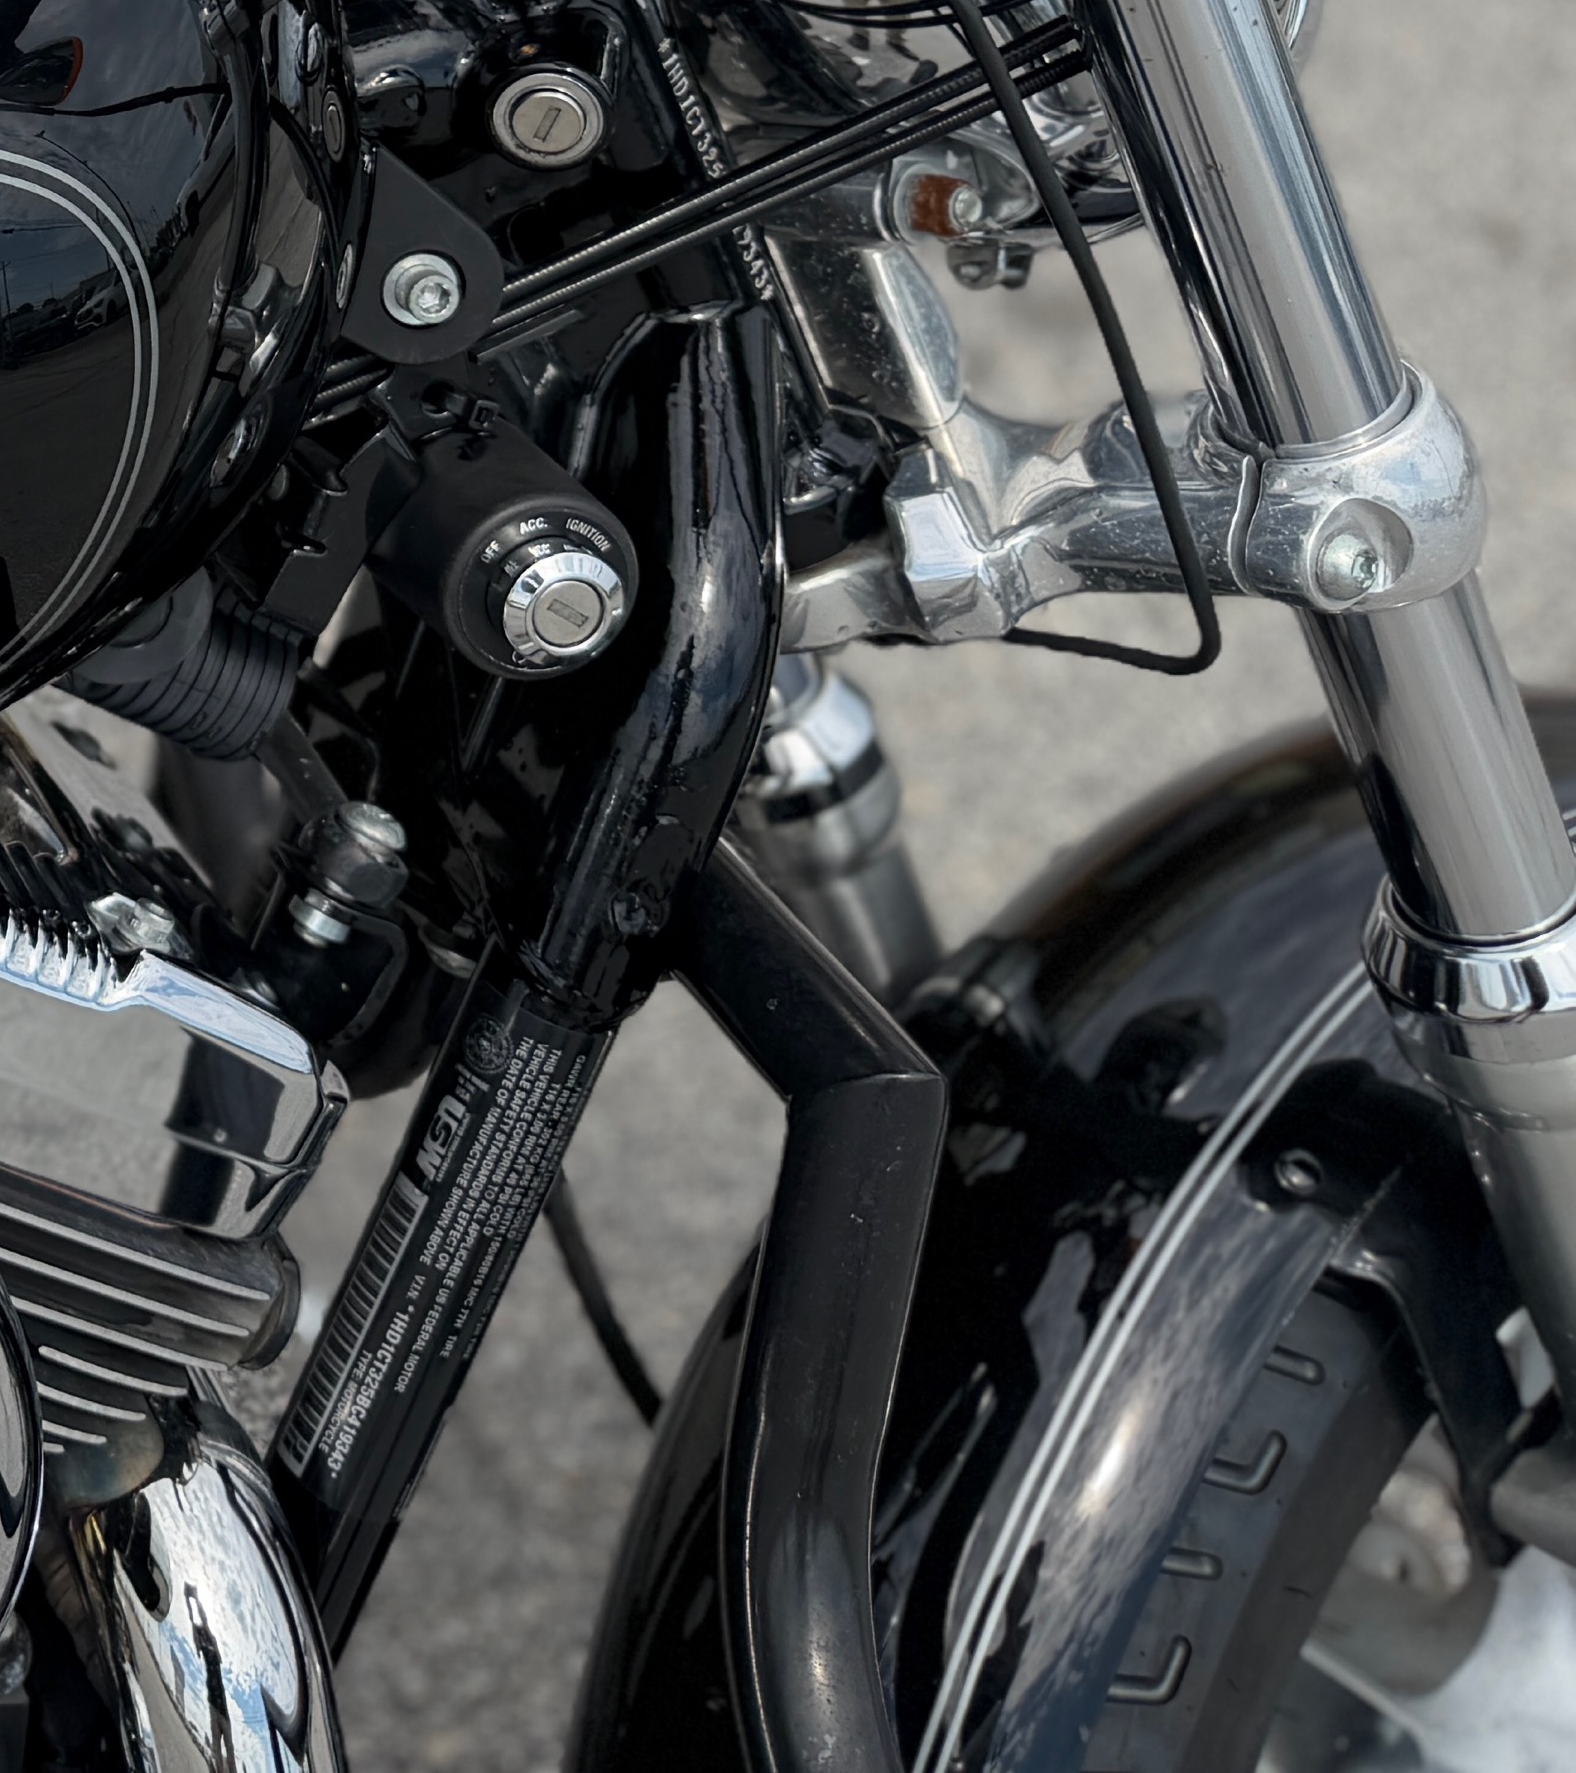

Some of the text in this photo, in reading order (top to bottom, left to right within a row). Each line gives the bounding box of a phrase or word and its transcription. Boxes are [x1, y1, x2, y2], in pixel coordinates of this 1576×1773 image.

[519, 517, 547, 534] ACC.
[566, 518, 612, 552] IGNITION
[480, 540, 500, 563] OFF
[515, 1036, 533, 1059] THE
[542, 1049, 561, 1072] THIS
[501, 1058, 522, 1089] DATE
[519, 1043, 548, 1089] VEHICLE
[495, 1088, 508, 1106] OF
[499, 1089, 526, 1132] SAFETY
[519, 1074, 549, 1120] VEHICLE
[455, 1107, 501, 1187] MANUFACTURE
[491, 1121, 527, 1183] CONFORMS
[529, 1146, 543, 1163] KG
[468, 1131, 506, 1198] STANDARDS
[513, 1155, 525, 1171] AT
[437, 1186, 463, 1228] SHOWN
[462, 1197, 475, 1210] IN
[484, 1184, 498, 1200] TO
[497, 1185, 512, 1204] PSI
[472, 1199, 490, 1219] ALL
[482, 1204, 503, 1236] COLD
[419, 1226, 443, 1265] ABOVE
[444, 1210, 469, 1253] EFFECT
[434, 1252, 449, 1270] ON
[442, 1221, 480, 1287] APPLICABLE
[435, 1288, 450, 1304] US
[411, 1304, 442, 1351] FEDERAL
[439, 1335, 457, 1357] TIRE
[394, 1353, 419, 1392] MOTOR
[315, 1349, 372, 1454] TYPE: MOTORCYCLE
